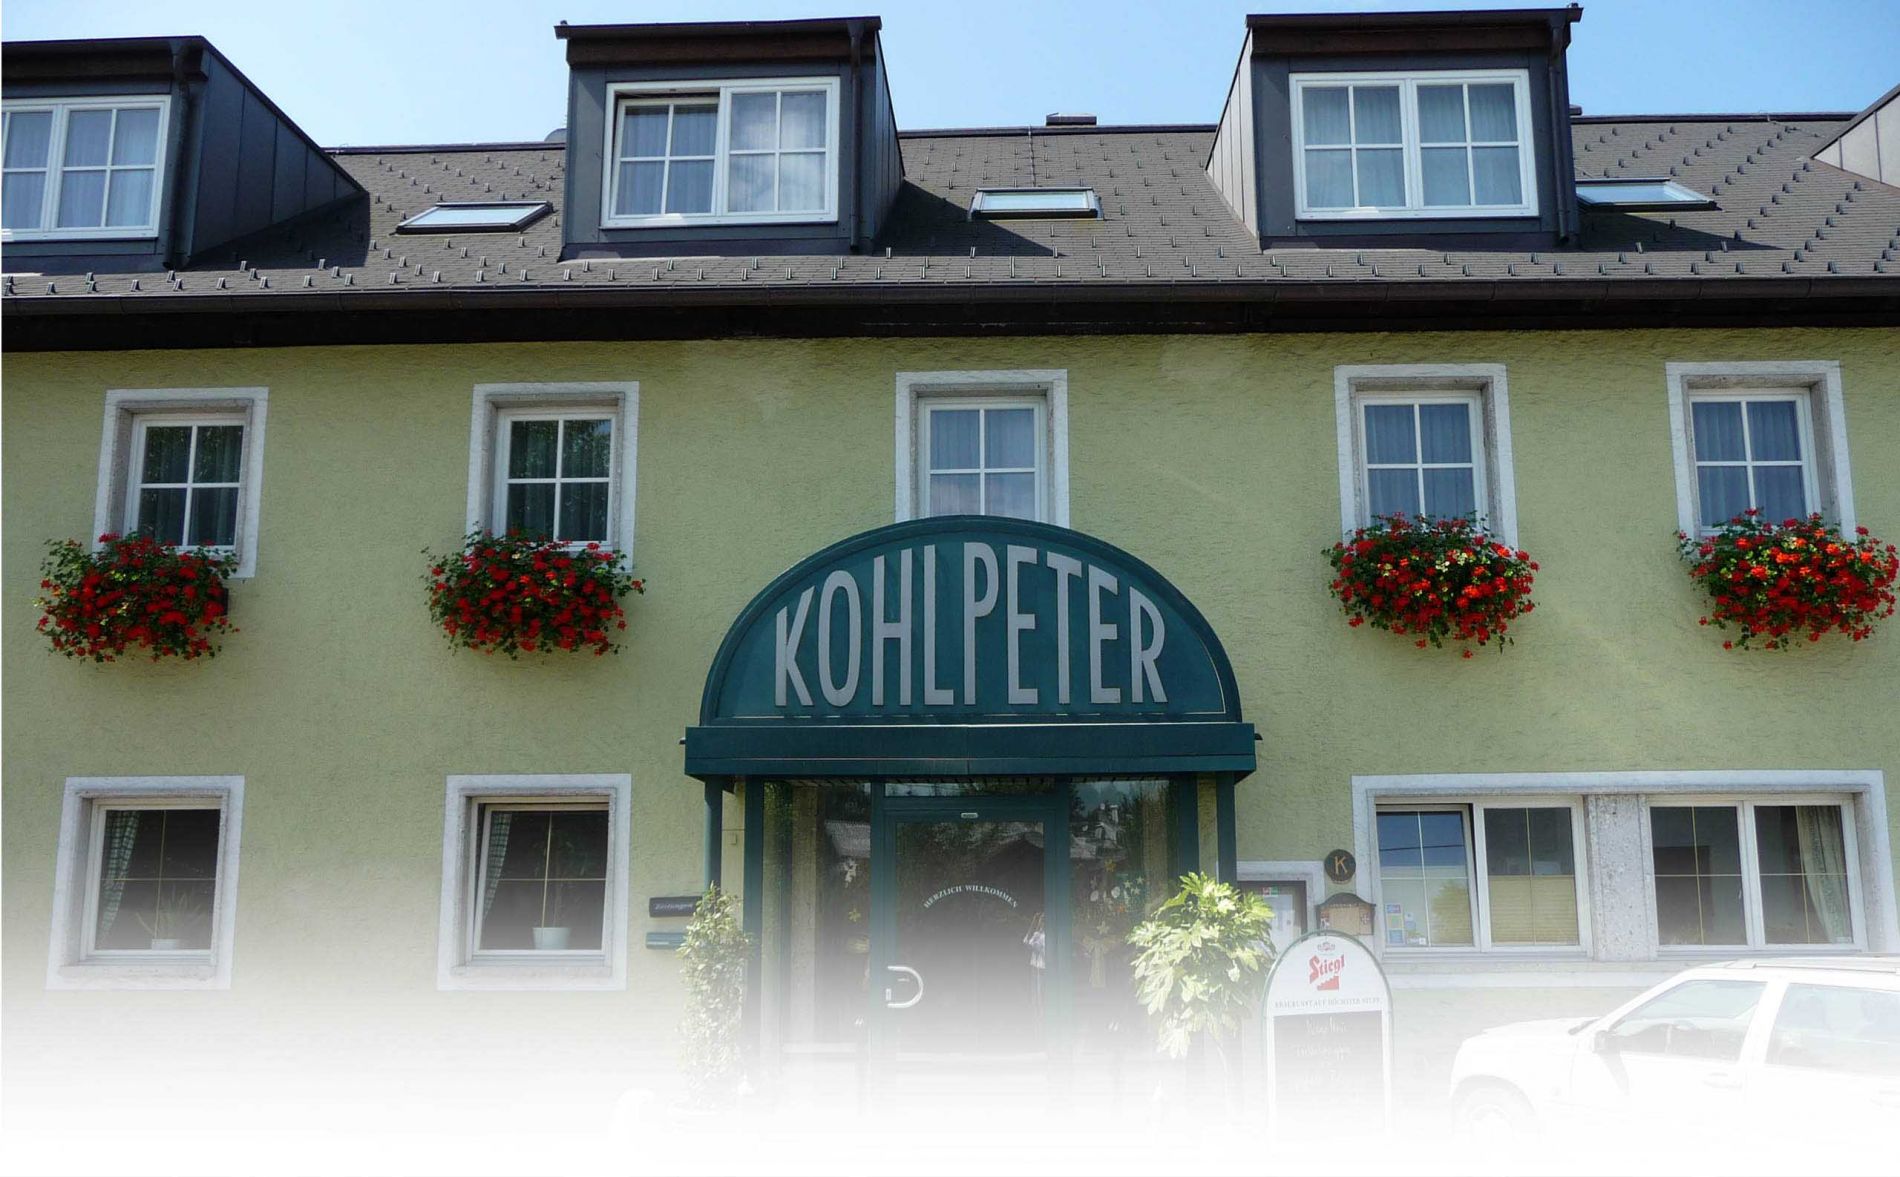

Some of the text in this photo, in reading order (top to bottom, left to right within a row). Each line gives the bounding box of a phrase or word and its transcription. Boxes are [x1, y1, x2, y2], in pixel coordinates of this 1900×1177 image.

[775, 542, 1168, 706] KOHLPETER
[1334, 856, 1348, 875] K
[923, 884, 1018, 909] HERZLICH WILLKOMMEN
[1309, 954, 1345, 984] Stiegl
